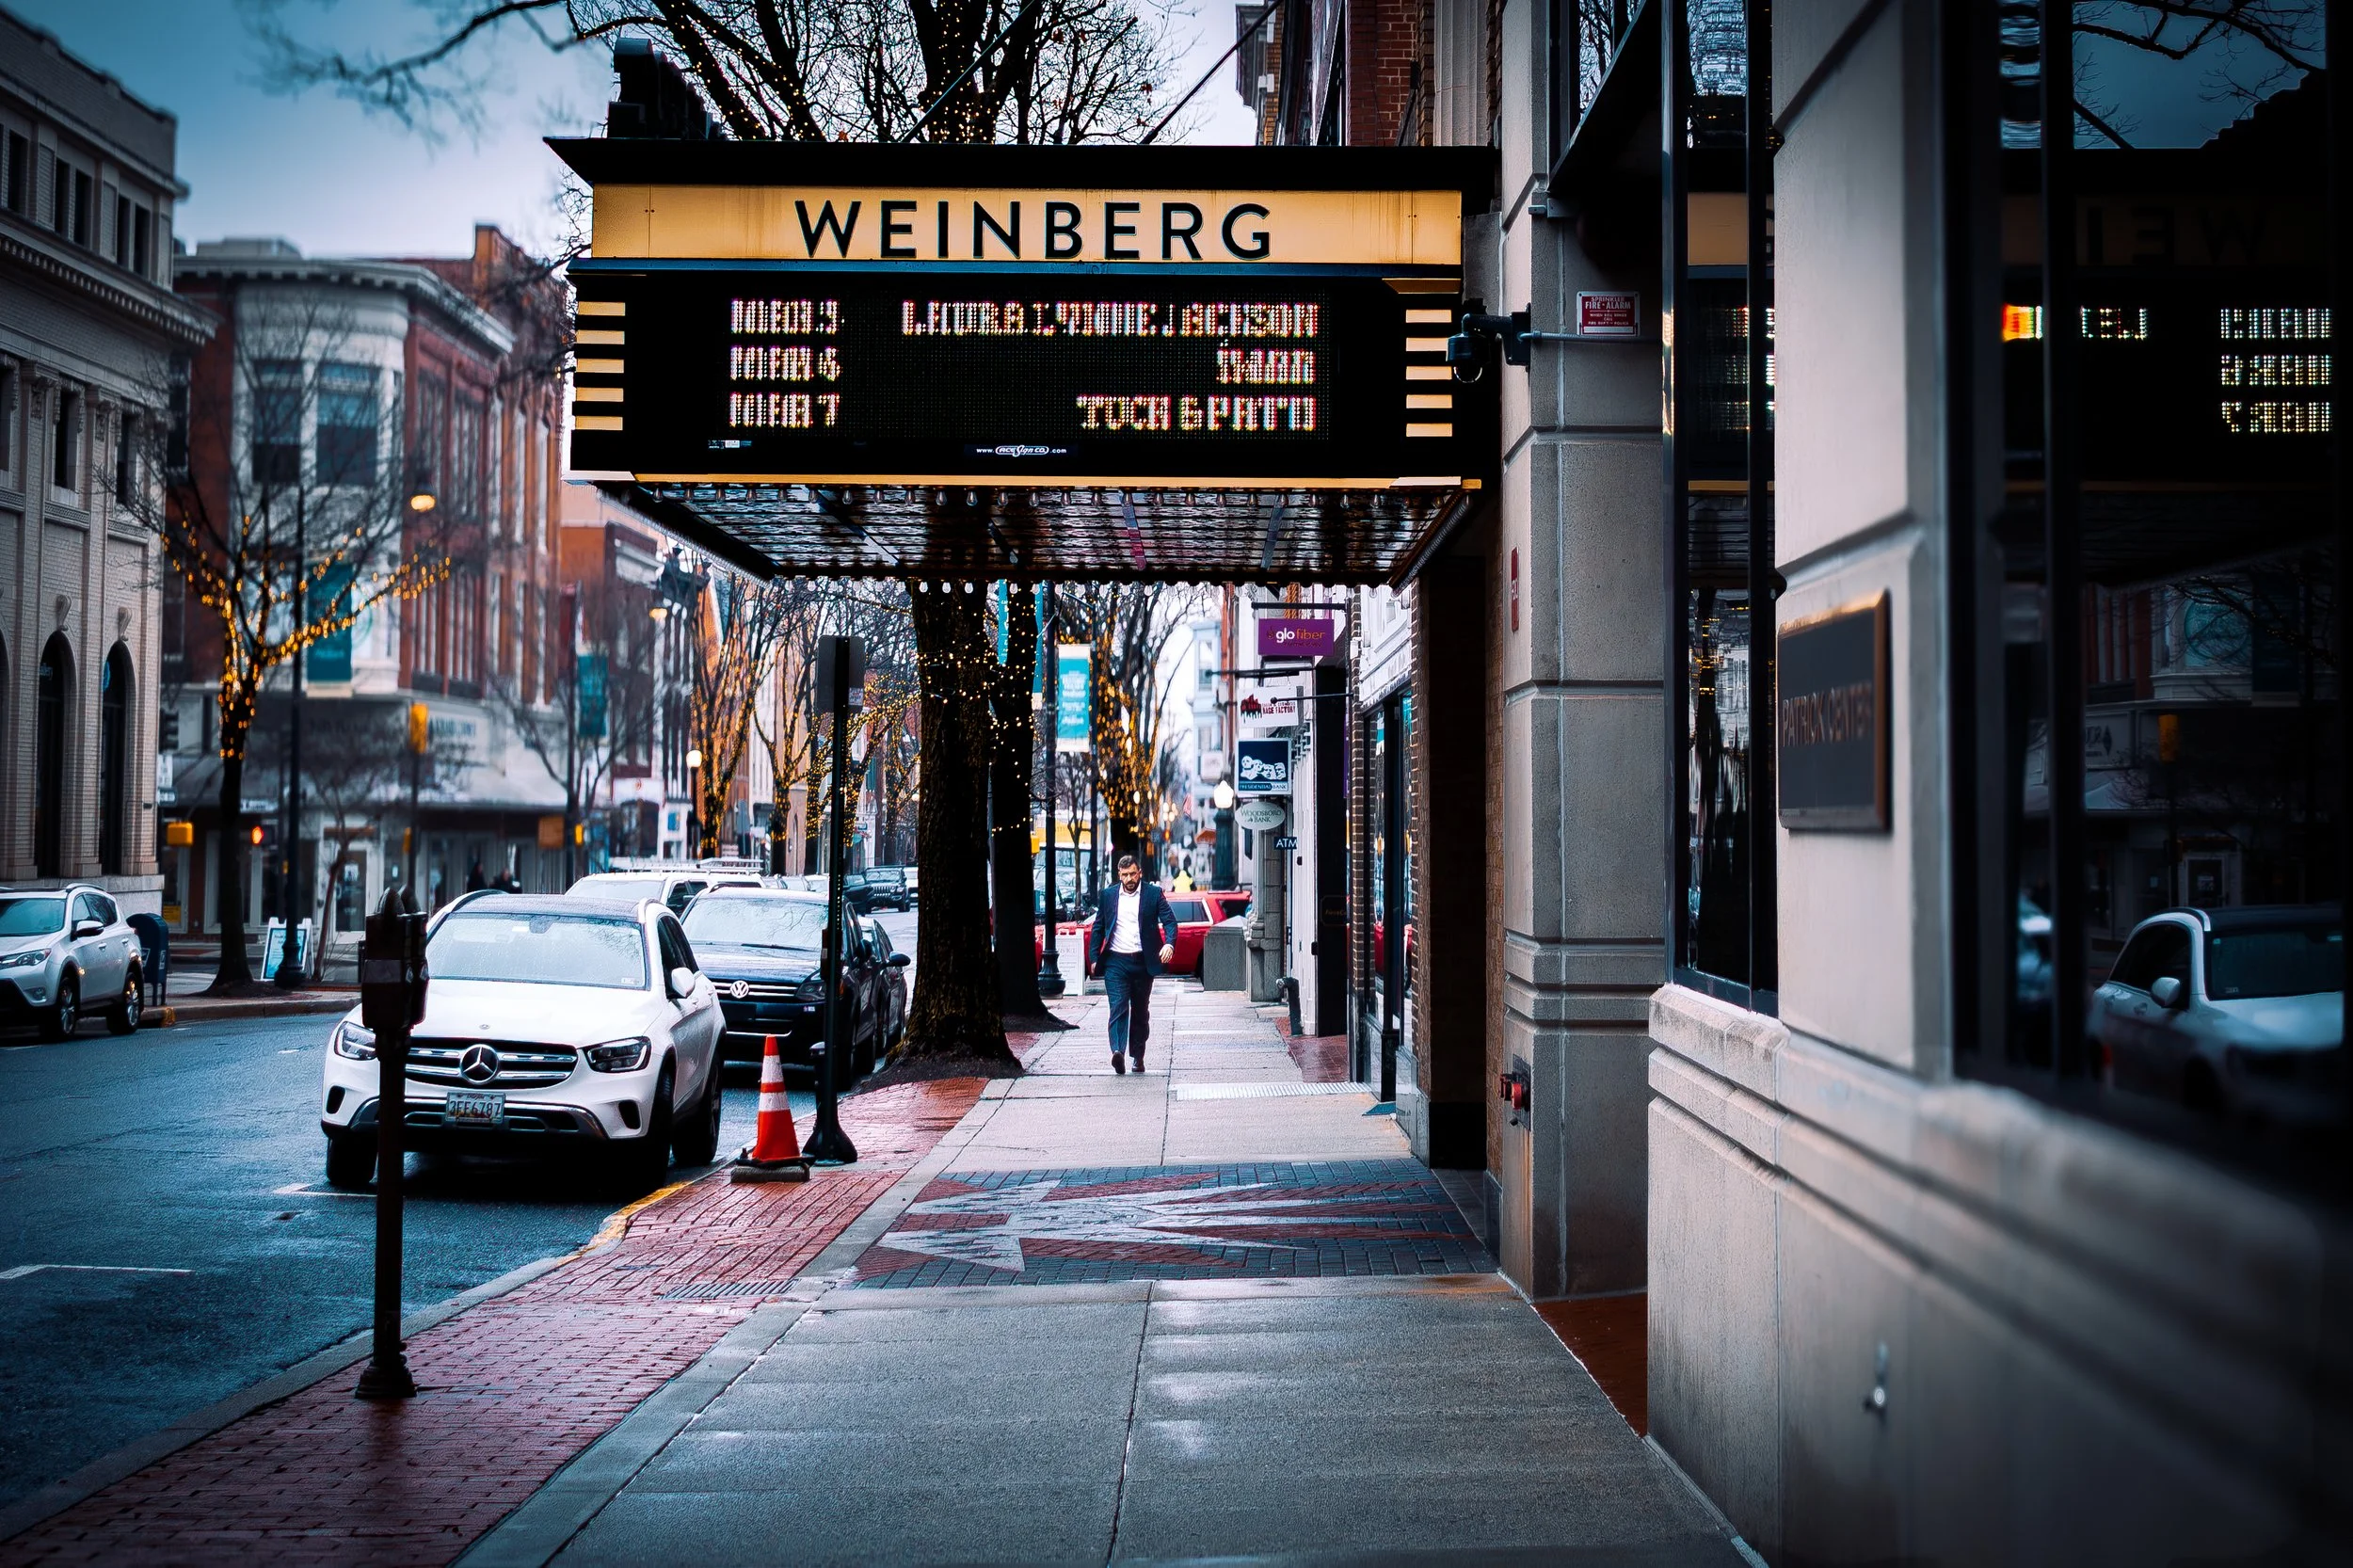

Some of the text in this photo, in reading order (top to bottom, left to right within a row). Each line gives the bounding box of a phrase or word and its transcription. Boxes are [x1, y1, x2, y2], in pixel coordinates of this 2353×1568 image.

[794, 200, 1272, 262] WEINBERG
[1585, 301, 1631, 310] FIRE ALARM
[817, 391, 840, 426] 7
[1275, 627, 1326, 644] glo fiber
[1783, 691, 1825, 747] PATRICK
[1275, 838, 1297, 848] ATM
